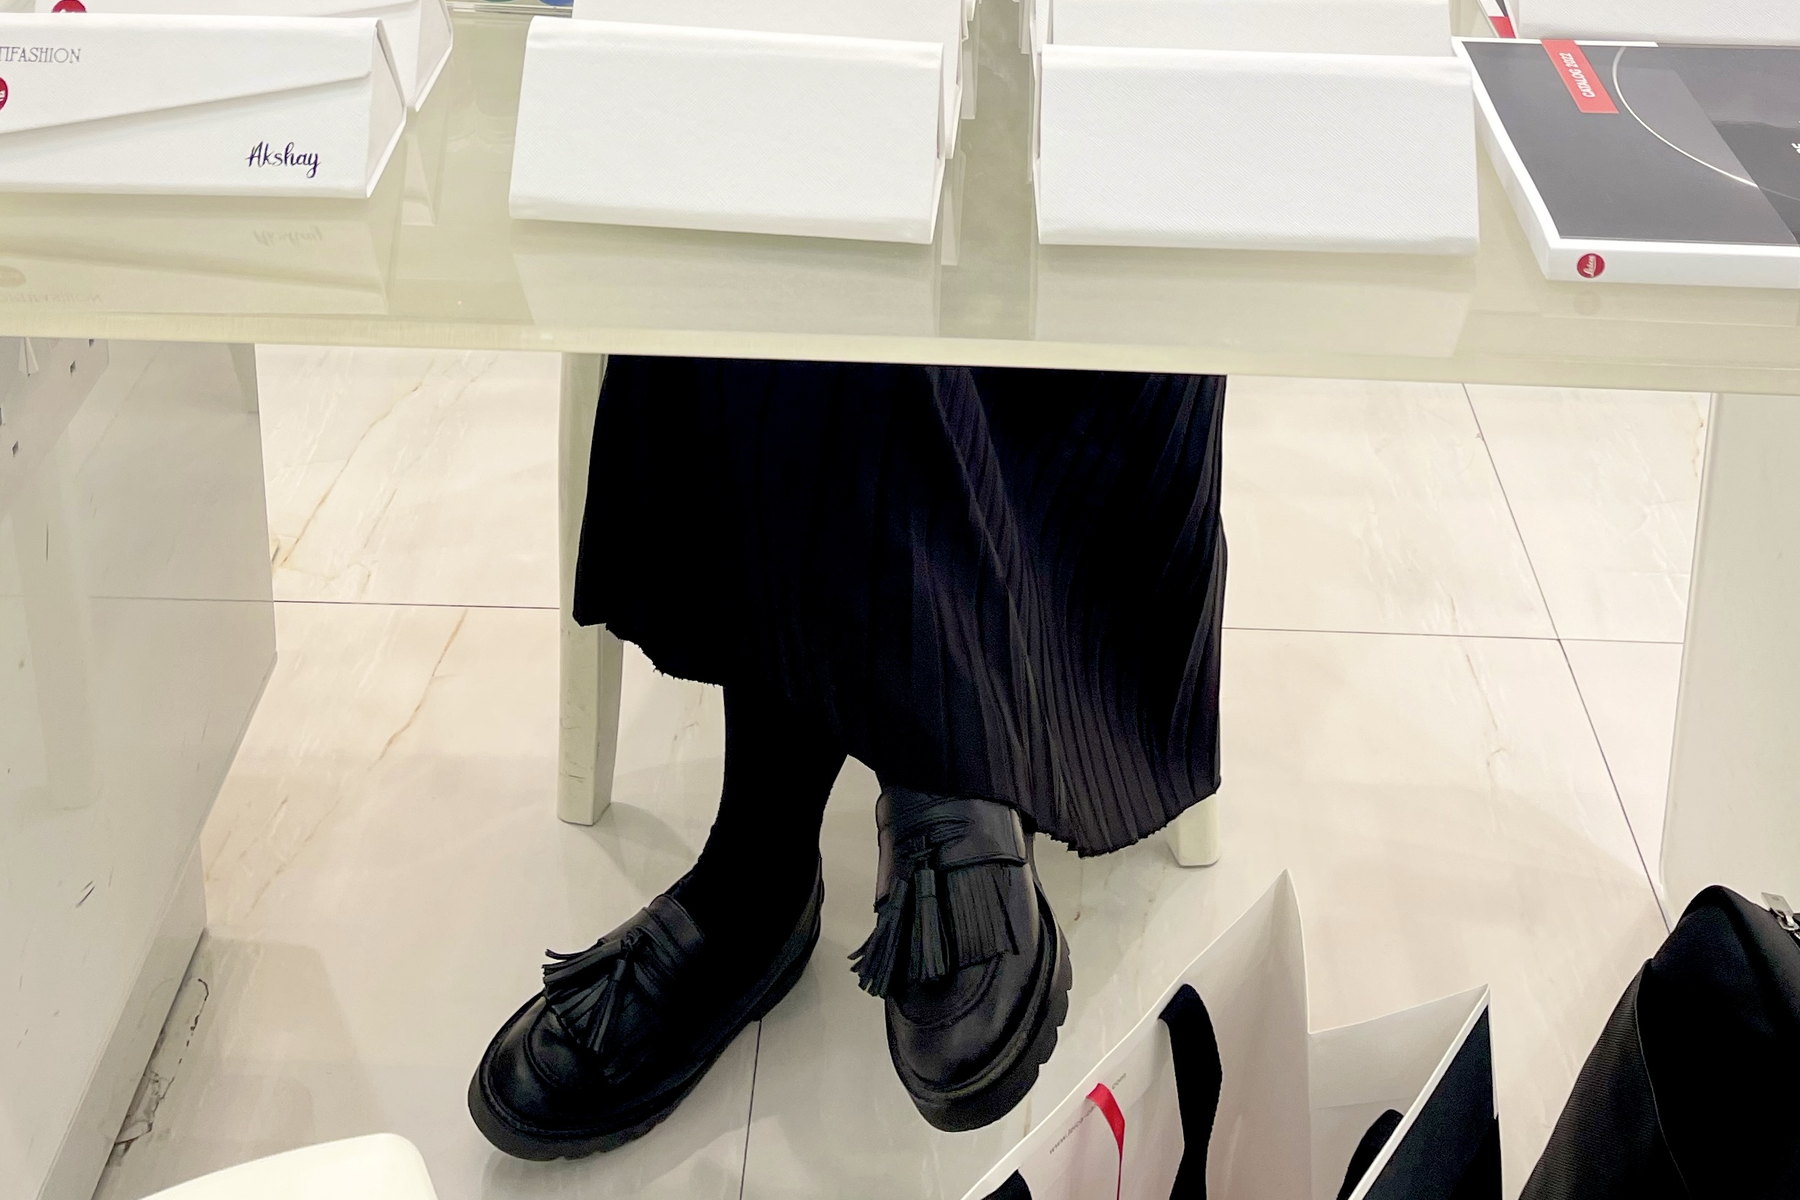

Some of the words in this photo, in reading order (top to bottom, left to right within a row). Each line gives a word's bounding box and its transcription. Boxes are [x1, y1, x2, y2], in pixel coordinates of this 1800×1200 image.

[1559, 52, 1579, 68] 2022
[1568, 68, 1596, 98] CATALOG
[245, 141, 321, 179] Akshay
